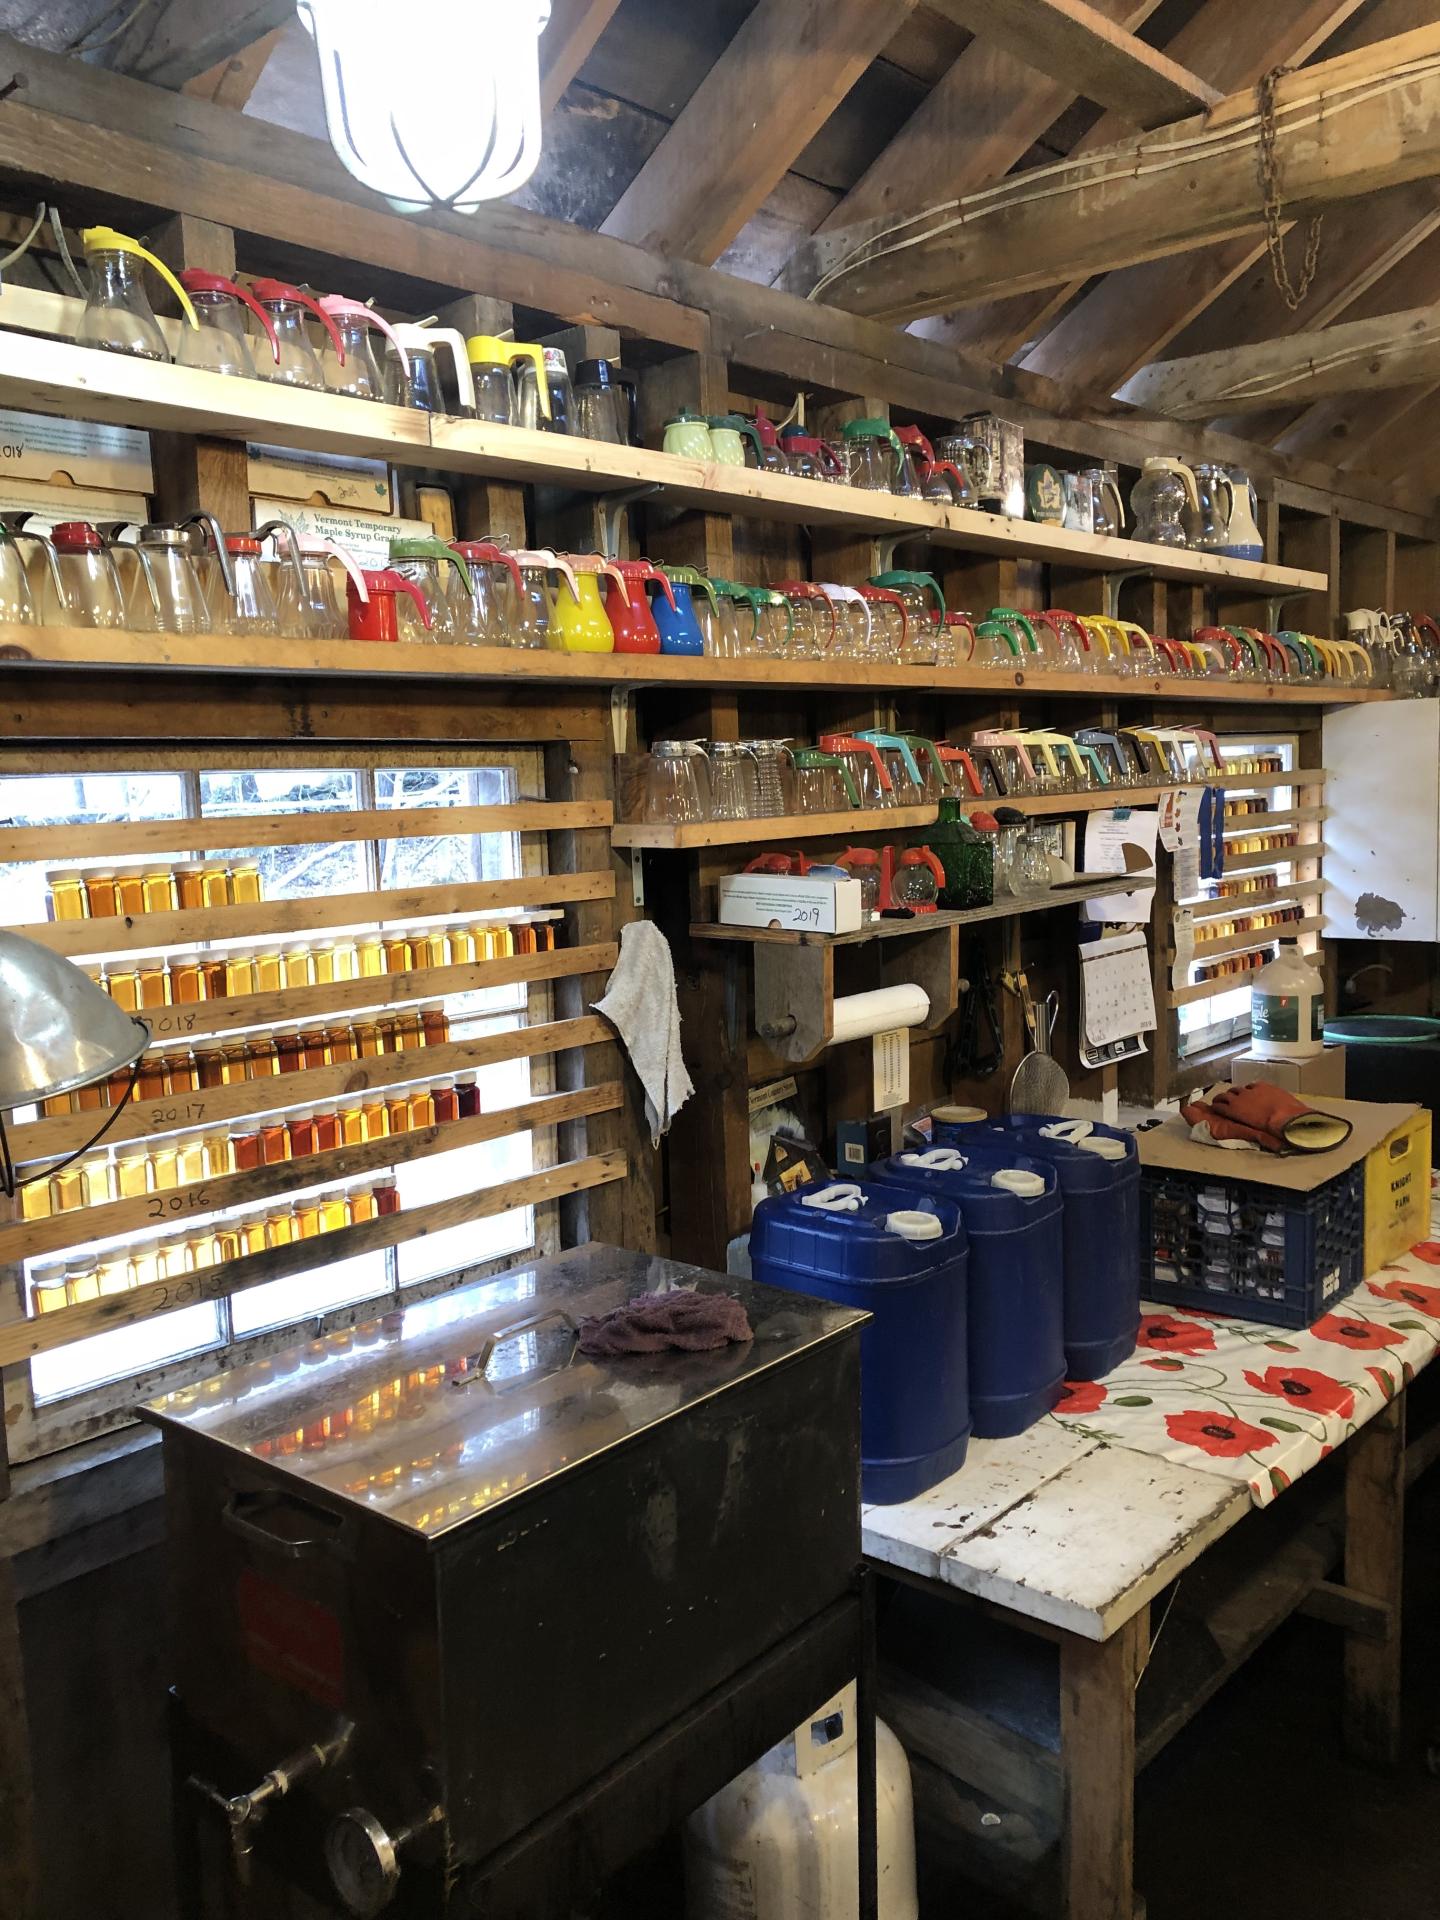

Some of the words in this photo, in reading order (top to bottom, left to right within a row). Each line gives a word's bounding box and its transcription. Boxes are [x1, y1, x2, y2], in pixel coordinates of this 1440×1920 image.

[0, 444, 24, 458] 018
[313, 513, 353, 527] Vermont
[354, 519, 401, 534] Temporary
[315, 525, 343, 537] Maple
[345, 529, 372, 541] Syrup
[373, 532, 402, 542] Gradi
[792, 908, 820, 926] 2019
[152, 1103, 206, 1124] 2017
[1391, 1171, 1411, 1192] KNIGHT
[148, 1190, 211, 1217] 2016
[1395, 1194, 1410, 1210] FARM
[152, 1272, 223, 1311] 2015
